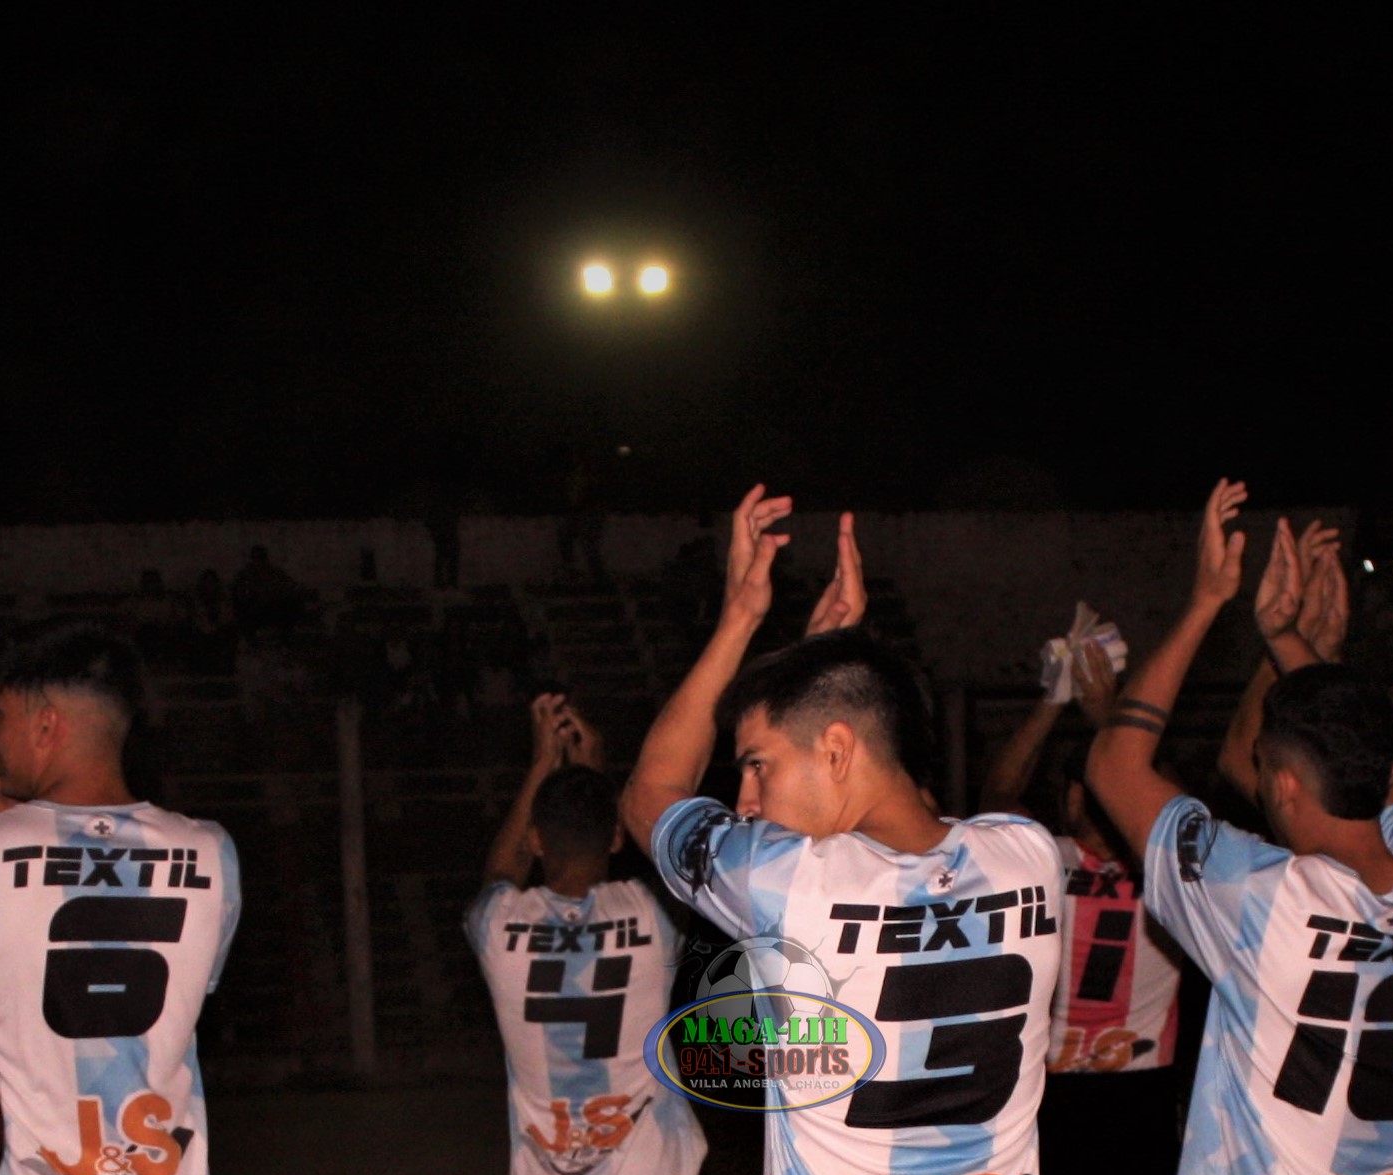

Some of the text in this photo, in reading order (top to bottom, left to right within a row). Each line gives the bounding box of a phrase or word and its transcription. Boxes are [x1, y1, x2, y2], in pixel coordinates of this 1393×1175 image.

[2, 846, 211, 889] TEXTIL
[504, 917, 652, 953] TEXTIL
[829, 885, 1057, 955] TEXTIL
[1077, 910, 1134, 1002] 1
[42, 895, 188, 1039] 6
[524, 954, 632, 1060] 4
[844, 953, 1033, 1129] 3
